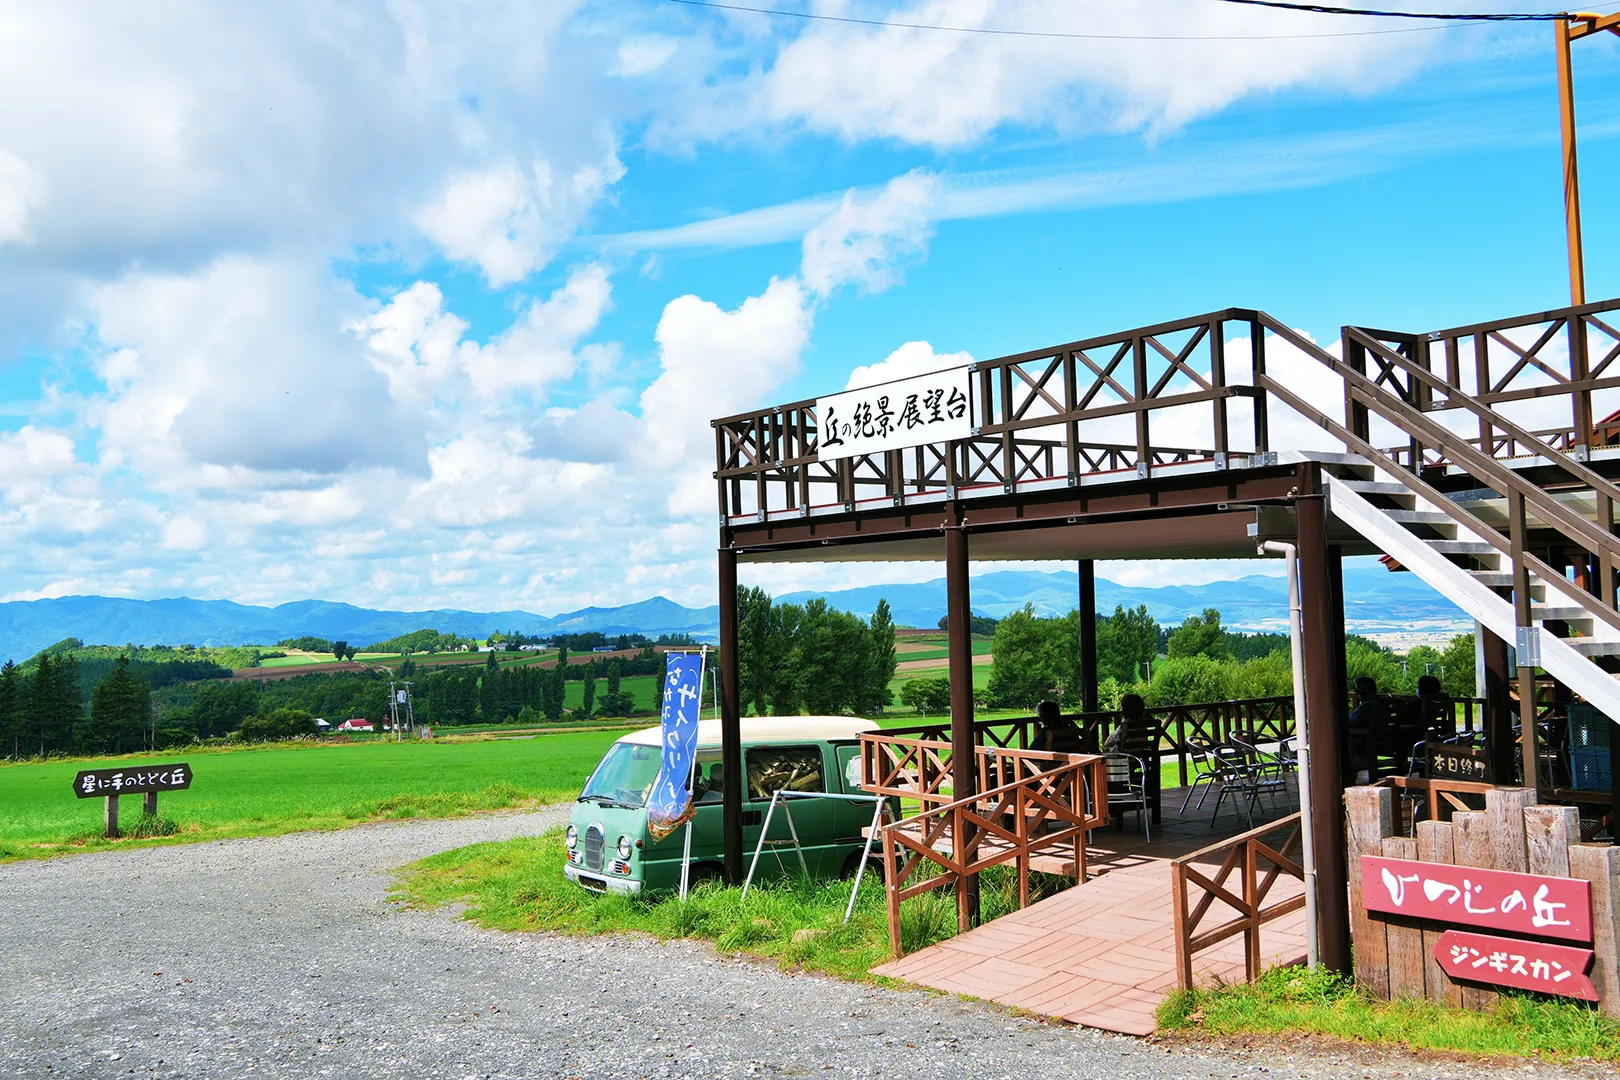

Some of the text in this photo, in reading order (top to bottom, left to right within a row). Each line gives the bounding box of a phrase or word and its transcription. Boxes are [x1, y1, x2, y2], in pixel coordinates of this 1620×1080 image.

[821, 386, 967, 448] 丘の絶景展望台
[81, 768, 185, 793] 星に手のとどく丘
[1433, 753, 1486, 779] 本日終了
[1380, 867, 1571, 928] ひつじの丘
[1449, 944, 1572, 983] ジンギスカン
